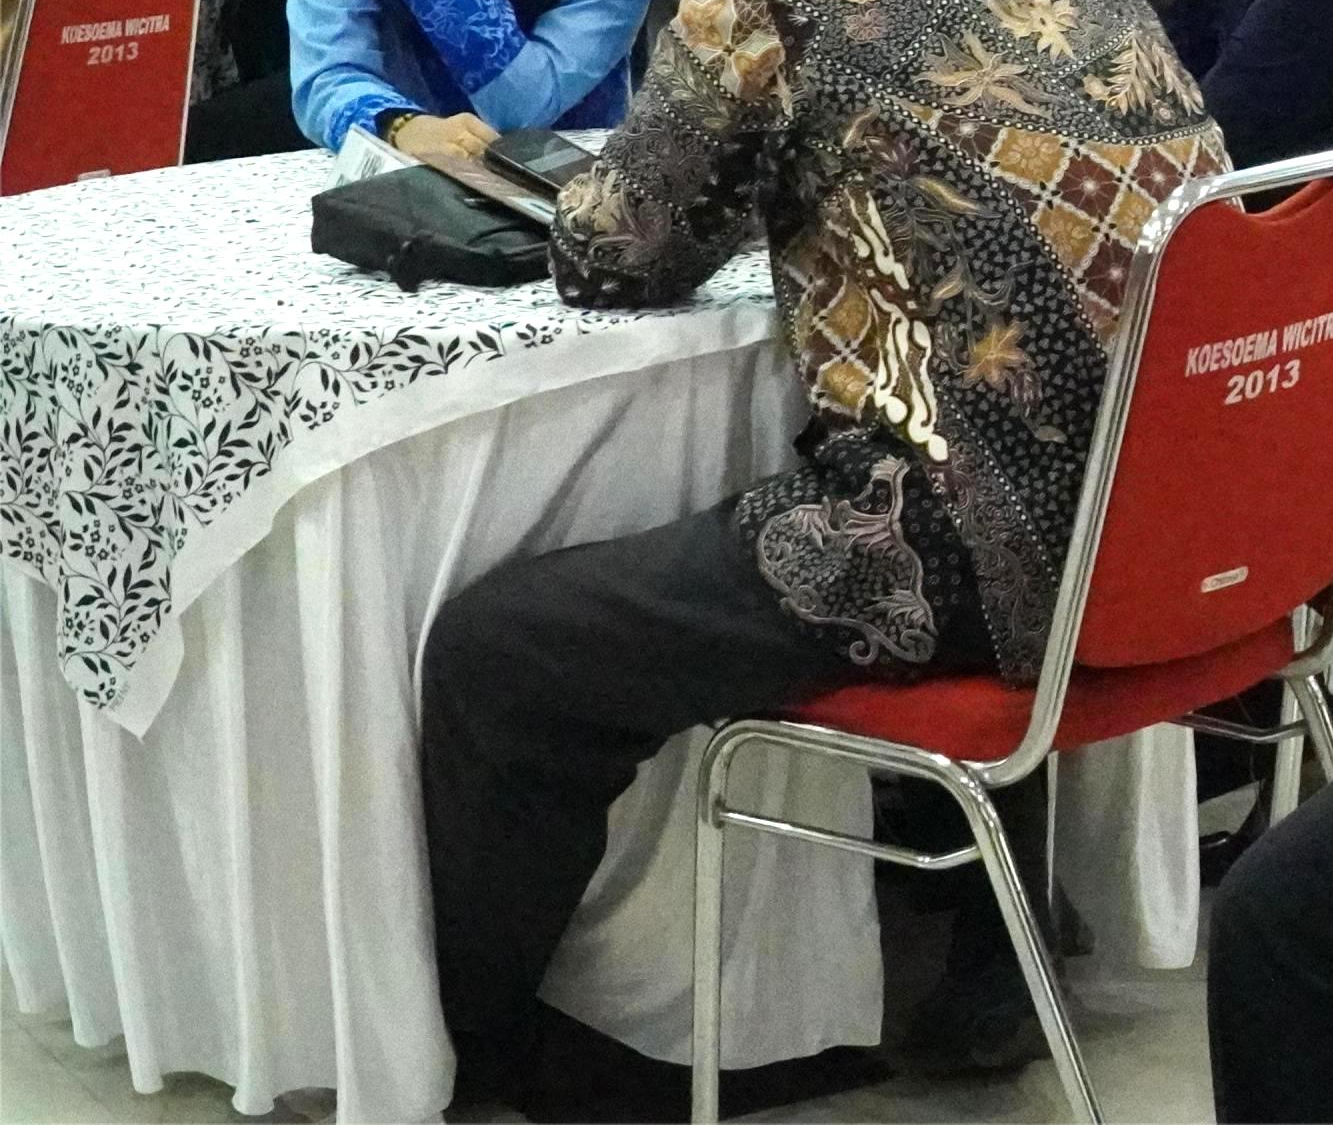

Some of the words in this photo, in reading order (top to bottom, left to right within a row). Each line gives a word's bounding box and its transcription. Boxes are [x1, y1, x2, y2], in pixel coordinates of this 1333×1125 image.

[60, 21, 123, 45] KOESOEMA
[124, 14, 170, 36] WICITRA
[87, 42, 140, 65] 2013
[1185, 328, 1278, 378] KOESOEMA
[1224, 359, 1301, 406] 2013
